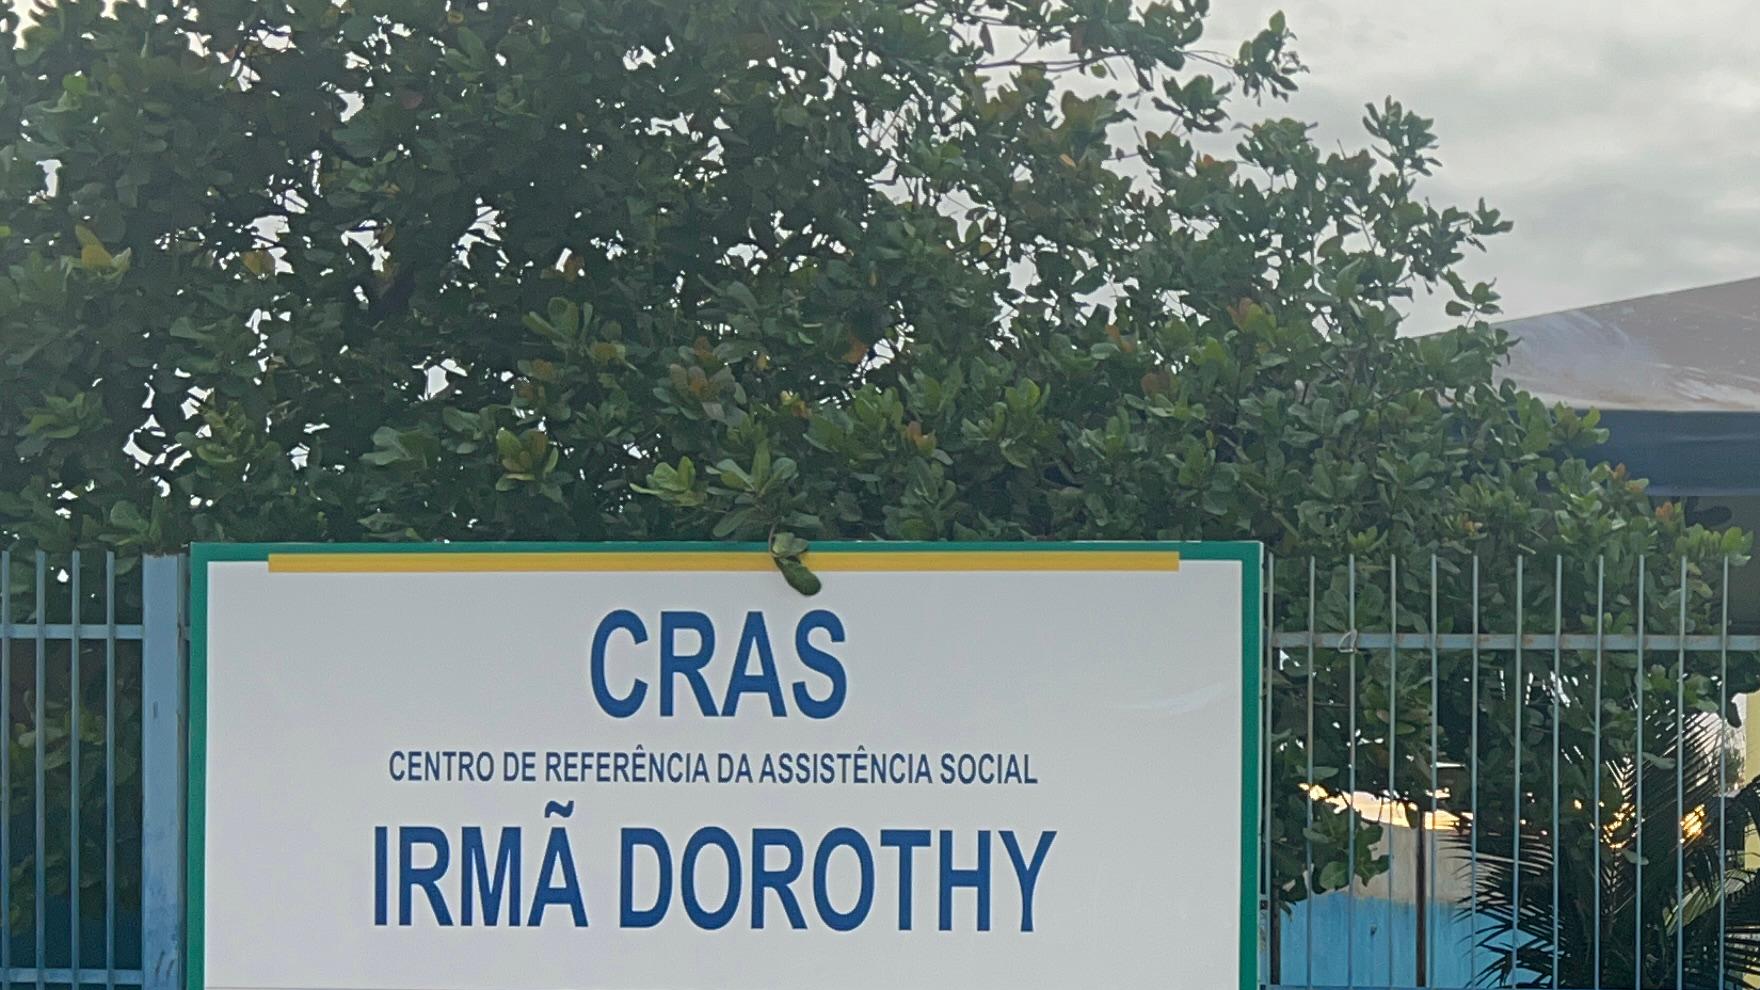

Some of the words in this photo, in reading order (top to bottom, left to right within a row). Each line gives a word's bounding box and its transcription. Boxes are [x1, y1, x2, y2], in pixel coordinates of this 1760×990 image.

[591, 609, 848, 720] CRAS
[389, 750, 495, 782] CENTRO
[503, 751, 537, 782] DE
[545, 744, 711, 784] REFERÊNCIA
[717, 752, 754, 784] DA
[758, 745, 933, 785] ASSISTÊNCIA
[939, 752, 1039, 785] SOCIAL
[374, 800, 589, 928] IRMÃ
[619, 825, 1058, 933] DOROTHY
